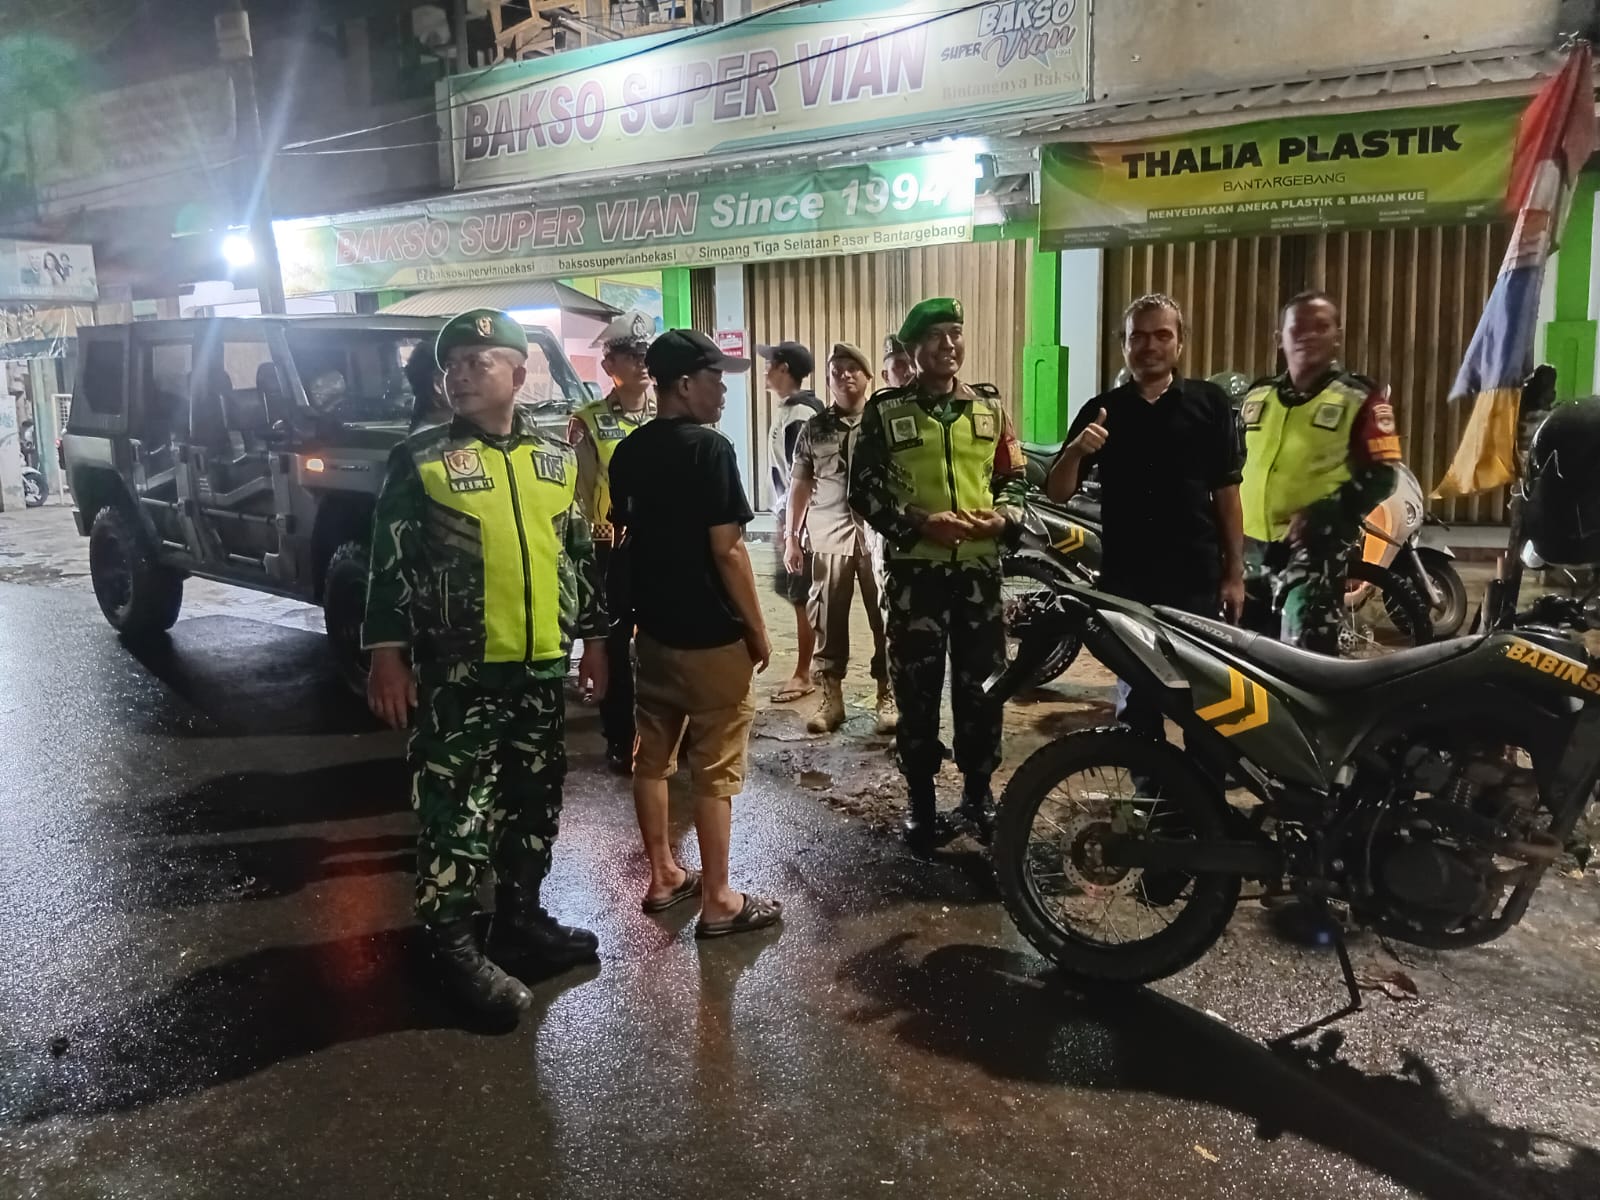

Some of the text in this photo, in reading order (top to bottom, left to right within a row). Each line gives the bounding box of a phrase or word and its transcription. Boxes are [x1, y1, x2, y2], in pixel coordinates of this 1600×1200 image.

[977, 0, 1076, 37] BAKSO
[941, 25, 1077, 67] SUPER Vian
[464, 25, 928, 161] BAKSO SUPER VIAN
[1033, 70, 1081, 87] Bakso
[1121, 124, 1463, 180] THALIA PLASTIK
[1223, 172, 1346, 192] BANTARGEBANG
[336, 173, 951, 267] BAKSO SUPER VIAN Since 1994
[1149, 191, 1425, 220] MENYEDIAKAN ANEKA PLASTIK & BAHAN KUE
[699, 224, 965, 259] Simpang Tiga Selatan Pasar Bantargebang
[558, 251, 677, 270] baksosupervianbekasi
[1506, 642, 1600, 695] BABINS
